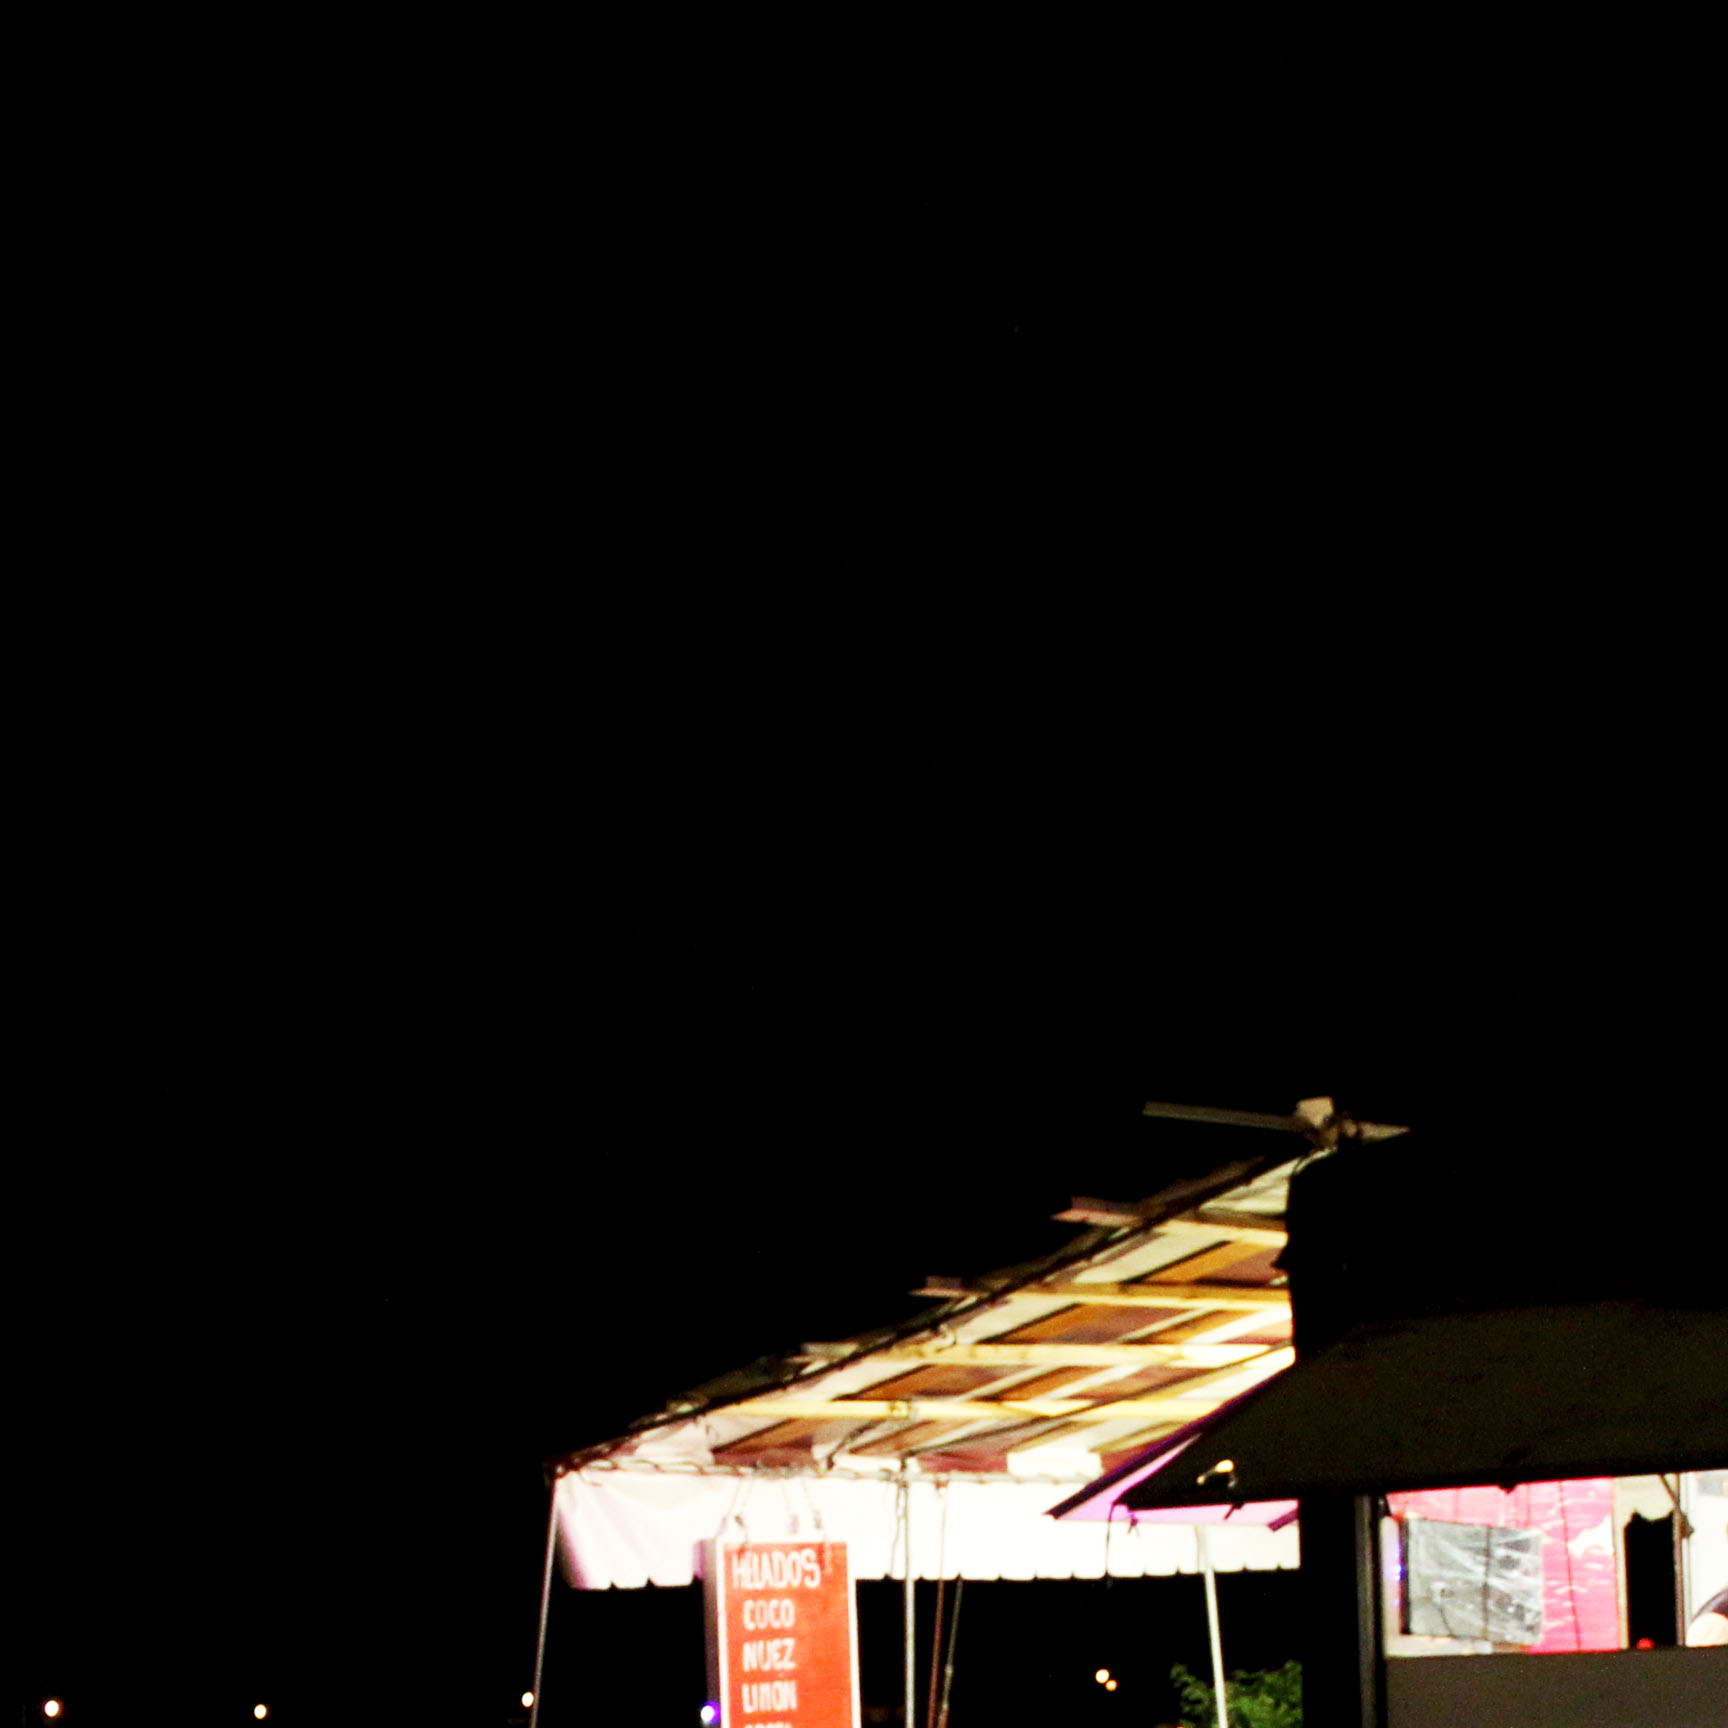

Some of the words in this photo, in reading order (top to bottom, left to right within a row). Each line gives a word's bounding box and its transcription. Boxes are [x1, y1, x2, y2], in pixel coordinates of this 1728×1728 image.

[732, 1548, 821, 1589] HELADOS
[743, 1598, 795, 1630] COCO
[743, 1638, 796, 1671] NUEZ
[741, 1681, 798, 1713] LIMON
